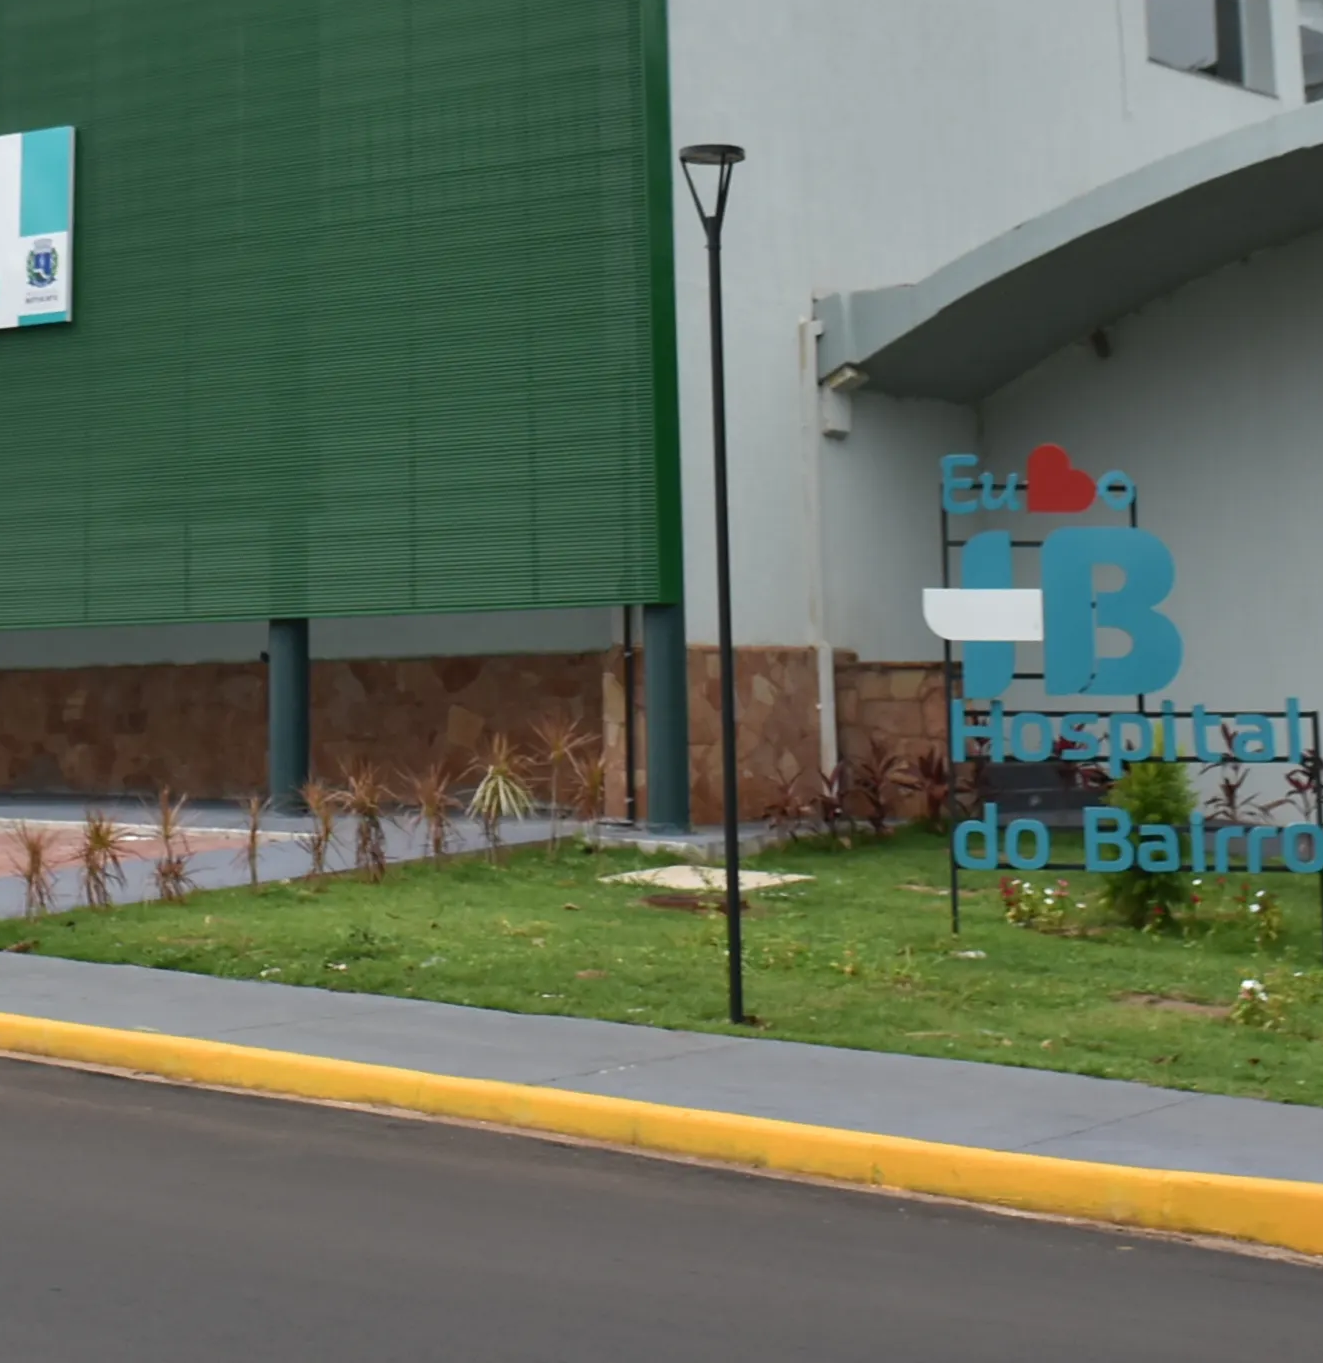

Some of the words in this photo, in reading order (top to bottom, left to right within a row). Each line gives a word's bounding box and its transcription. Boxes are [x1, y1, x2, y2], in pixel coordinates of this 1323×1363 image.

[940, 454, 1022, 513] Eu
[951, 697, 1303, 778] Hospital
[954, 802, 1050, 870] do
